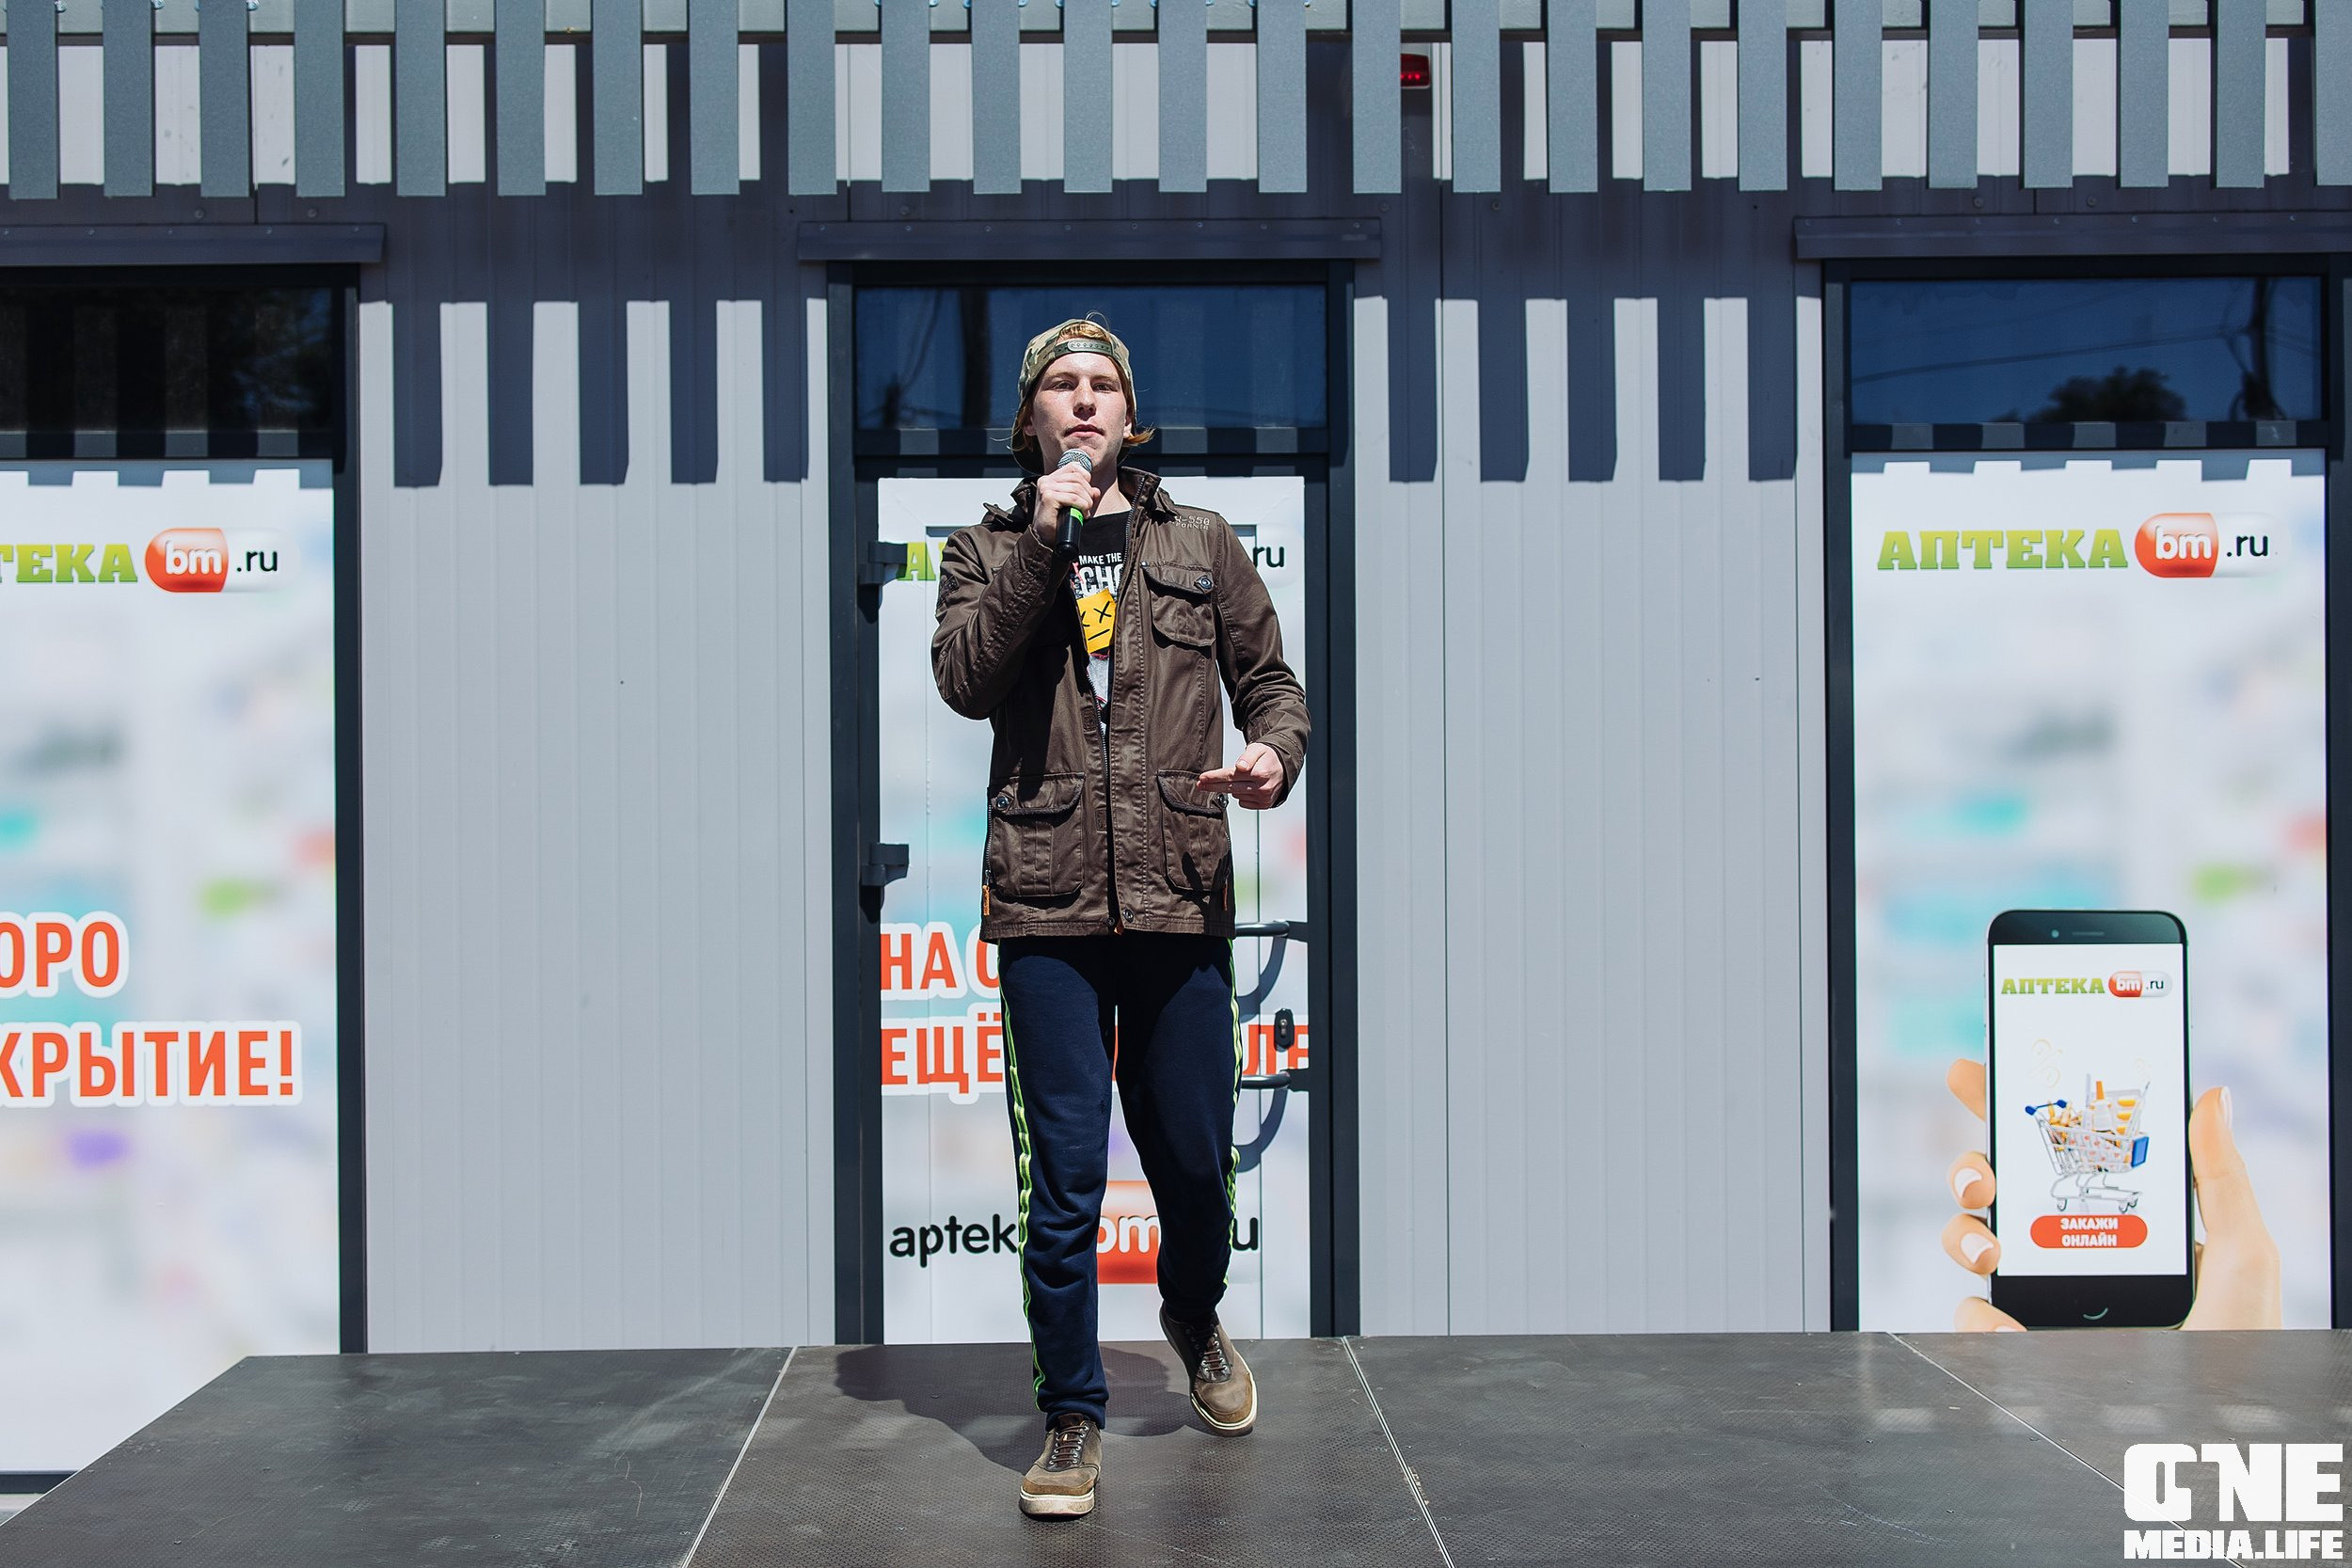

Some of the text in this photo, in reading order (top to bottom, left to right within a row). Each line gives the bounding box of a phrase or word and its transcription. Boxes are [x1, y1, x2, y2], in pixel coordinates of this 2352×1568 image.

[1078, 552, 1123, 565] MAKE THE
[1253, 546, 1285, 568] ru
[1877, 529, 2129, 570] АПТЕКА
[880, 932, 958, 990] НА
[2001, 977, 2106, 995] АПТЕКА
[881, 1012, 1004, 1094] ЕЩЁ
[2059, 1217, 2119, 1230] ЗАКАЖИ
[889, 1213, 1018, 1269] aptek
[2061, 1232, 2118, 1247] ОНЛАЙН
